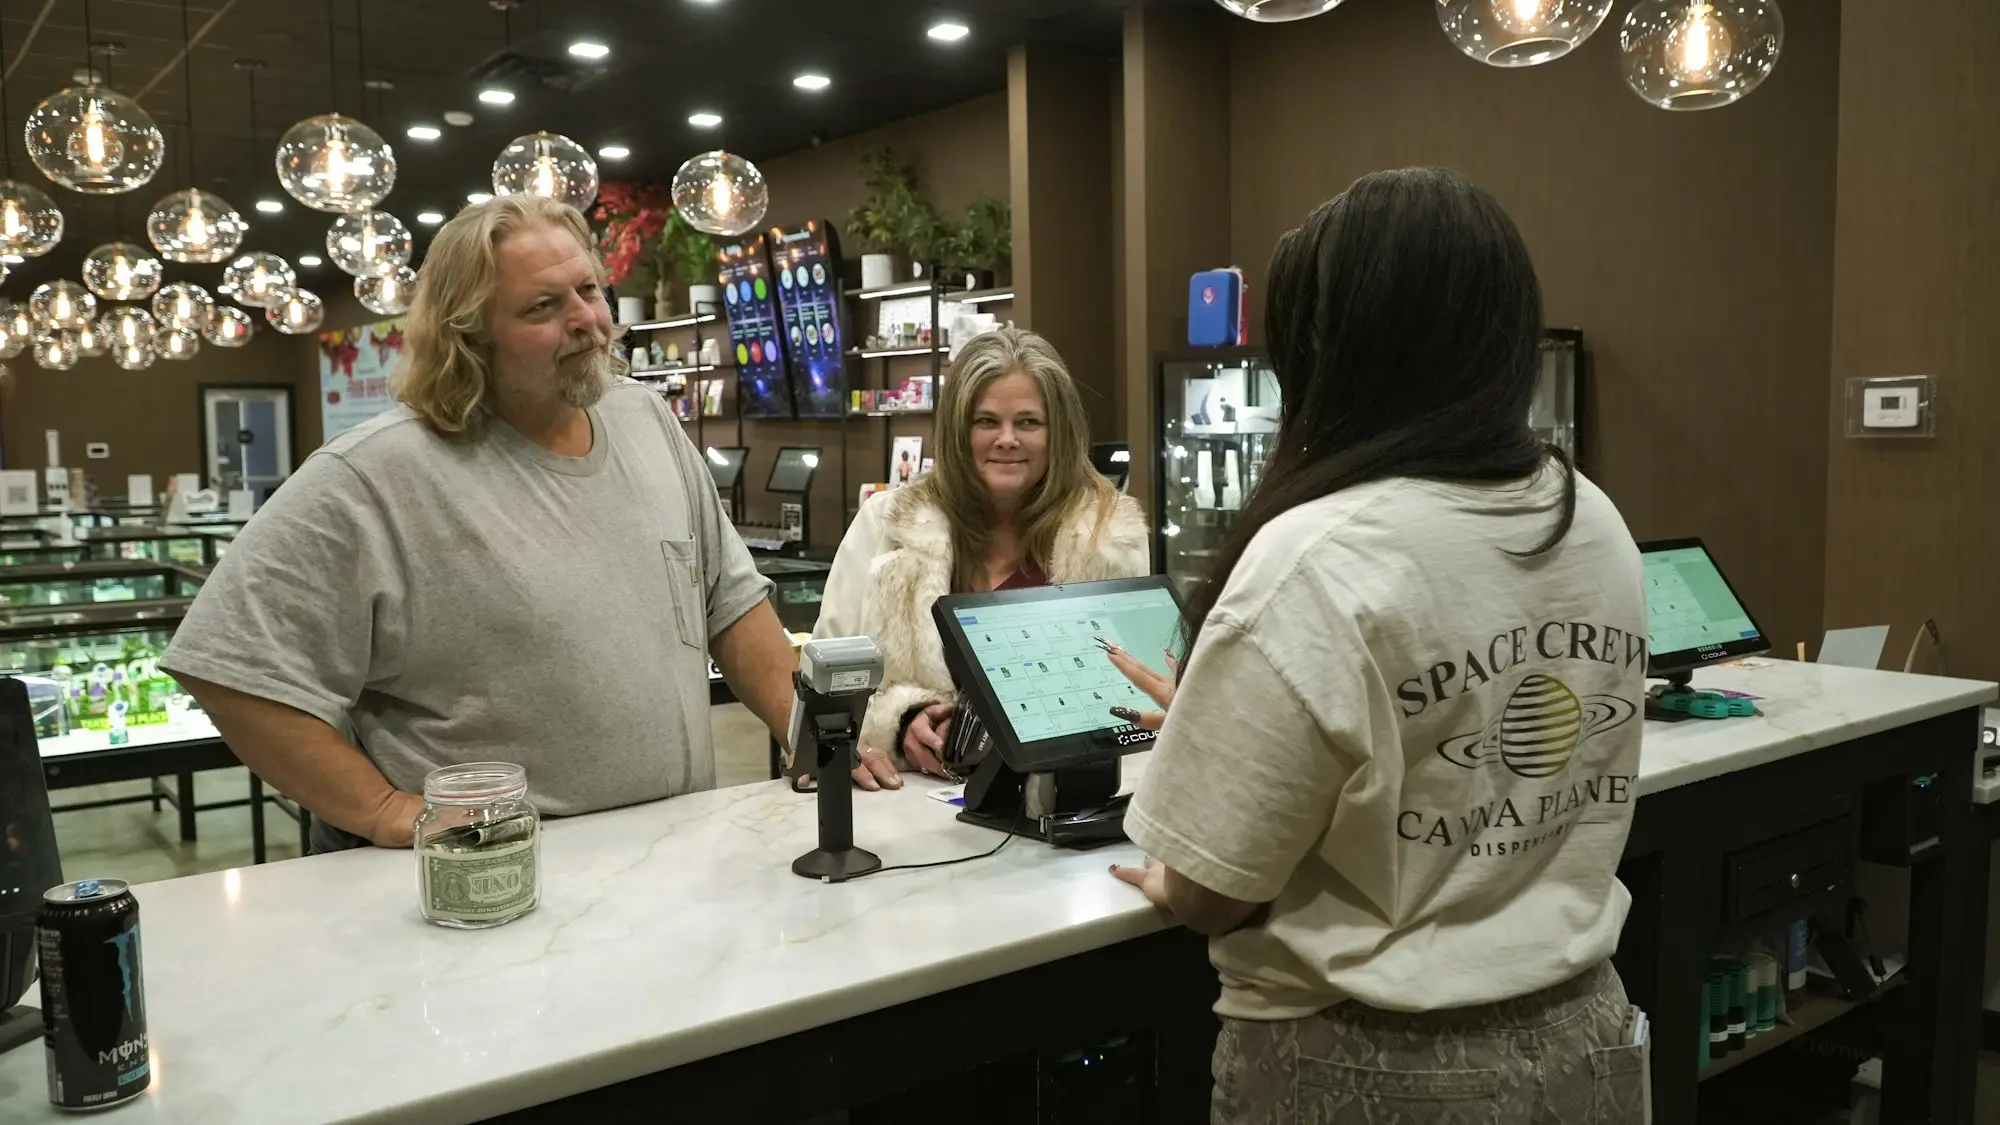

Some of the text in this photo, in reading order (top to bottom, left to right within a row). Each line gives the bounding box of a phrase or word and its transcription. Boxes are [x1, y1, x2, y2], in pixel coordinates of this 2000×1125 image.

[1397, 621, 1647, 719] SPACE CREW
[471, 874, 519, 896] ONE
